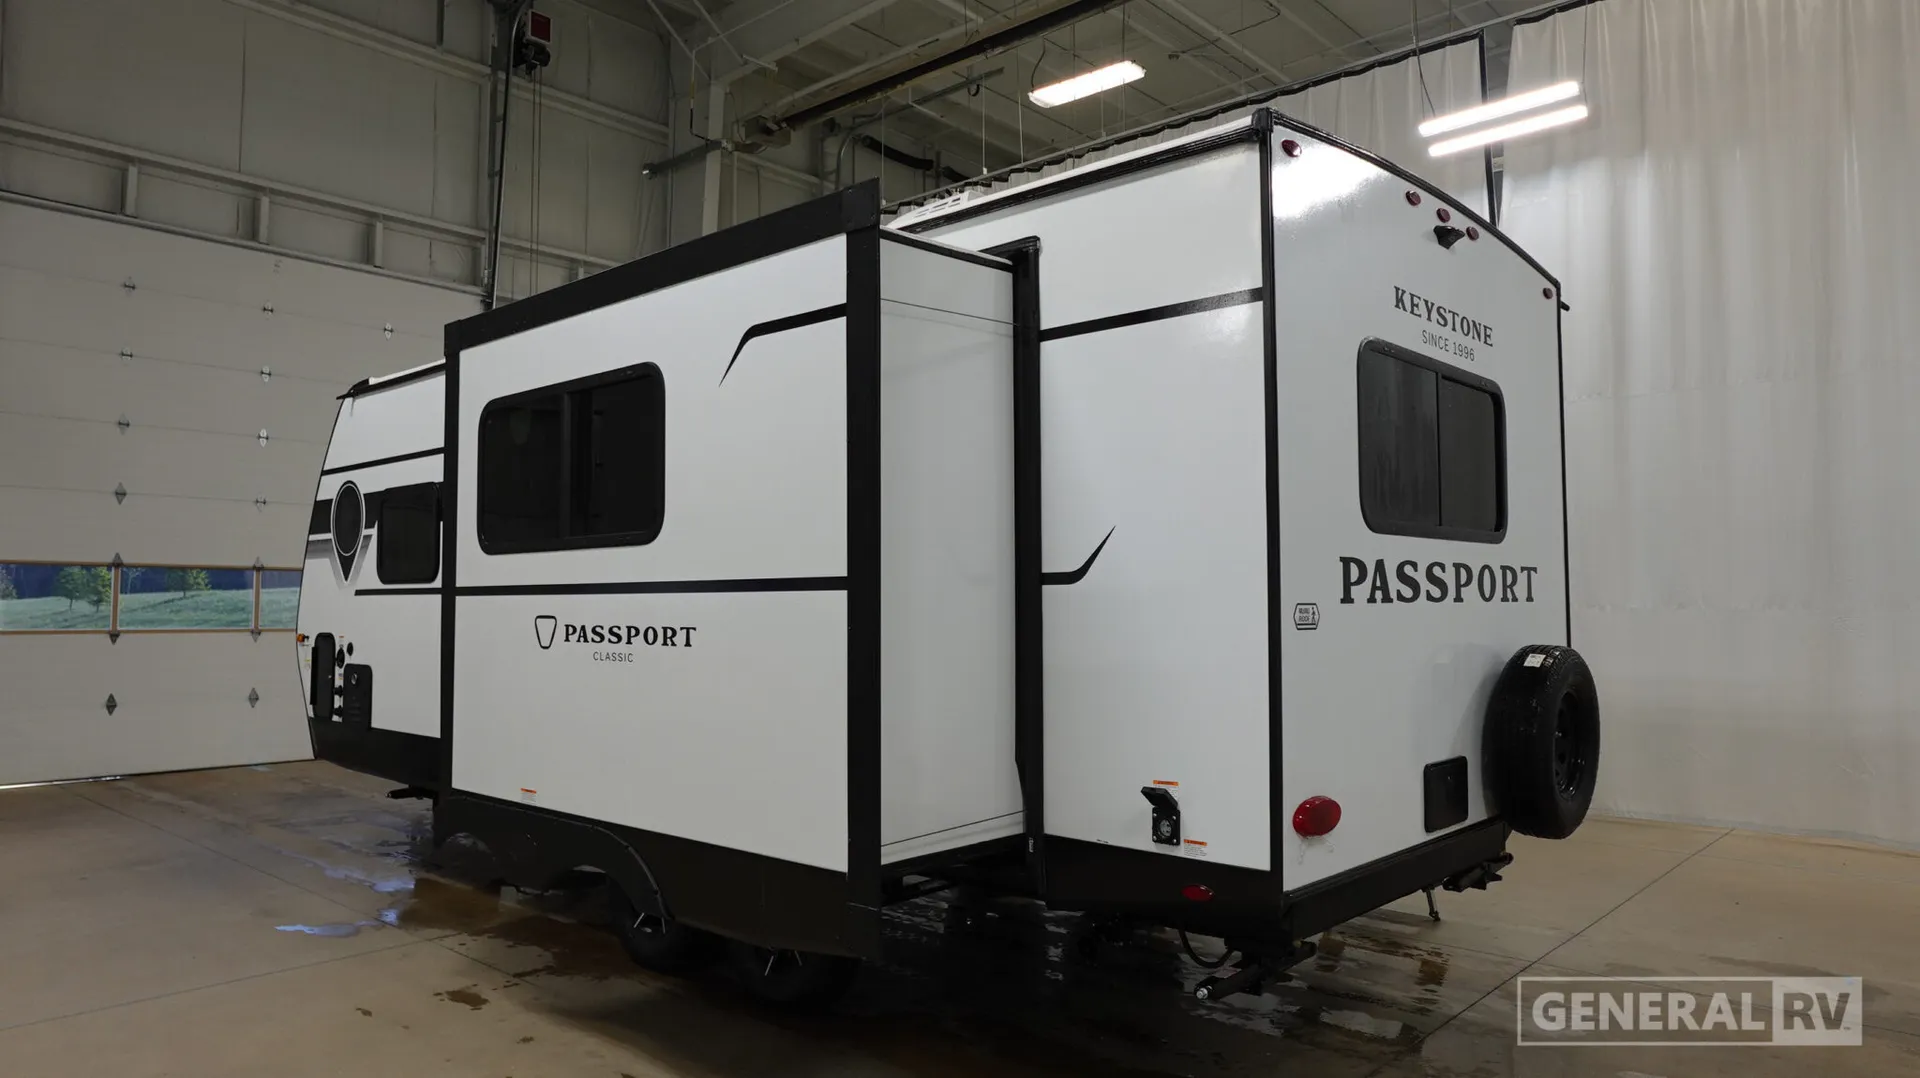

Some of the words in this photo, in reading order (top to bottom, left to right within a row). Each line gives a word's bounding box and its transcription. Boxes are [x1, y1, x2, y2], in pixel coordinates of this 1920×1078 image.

[1394, 286, 1494, 348] KEYSTONE
[1421, 329, 1450, 353] SINCE
[1453, 341, 1475, 362] 1996
[1340, 556, 1538, 605] PASSPORT
[564, 624, 697, 647] PASSPORT
[593, 651, 634, 663] CLASSIC
